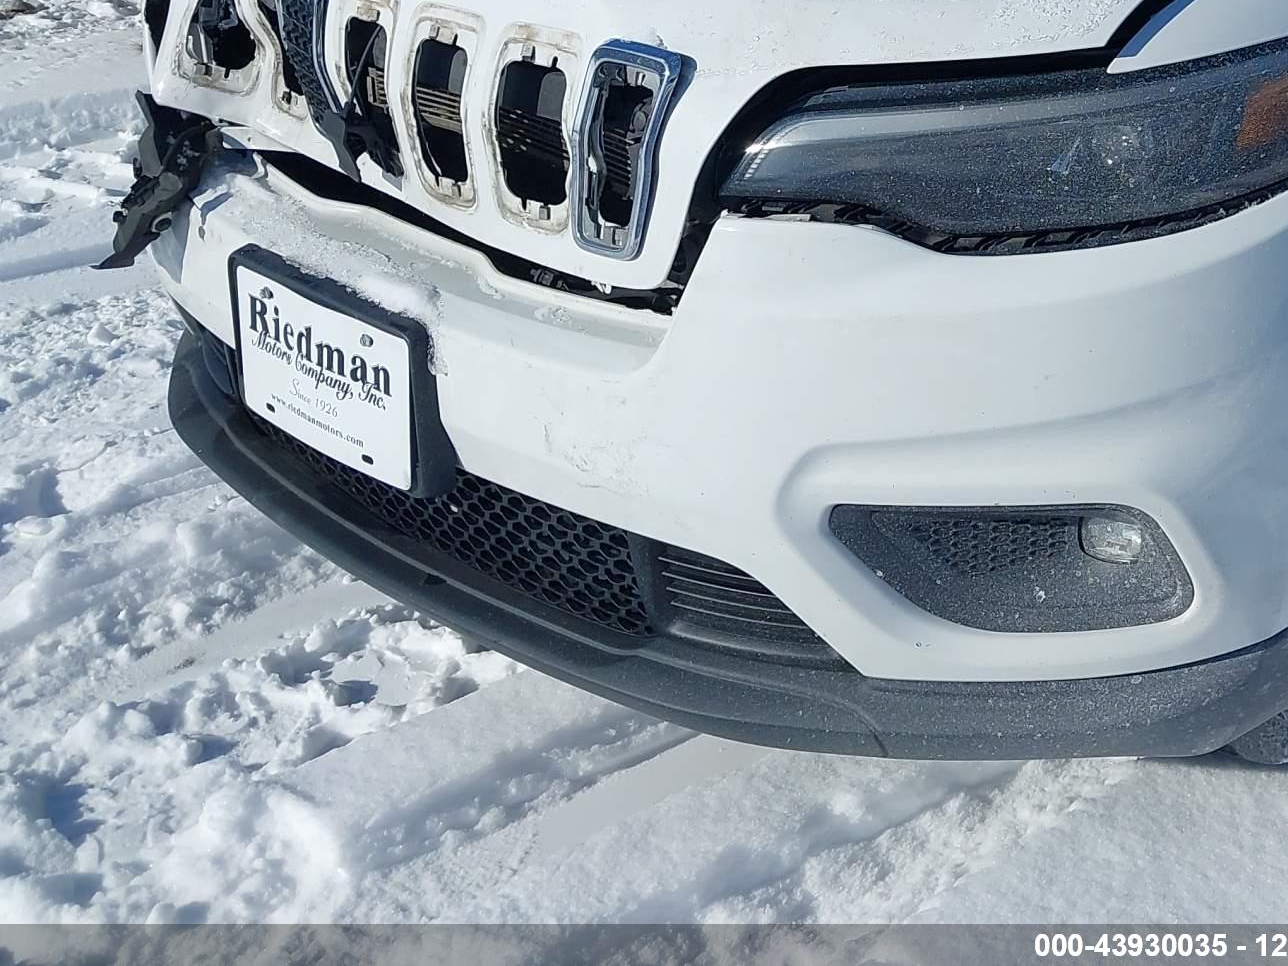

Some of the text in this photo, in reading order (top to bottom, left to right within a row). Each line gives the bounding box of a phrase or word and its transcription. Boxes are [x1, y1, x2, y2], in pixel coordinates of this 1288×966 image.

[249, 293, 392, 397] Riedman
[252, 330, 293, 366] Motors
[295, 351, 353, 401] Company,
[271, 393, 364, 448] www.riedmanmotors.com
[289, 377, 339, 418] Since 1926
